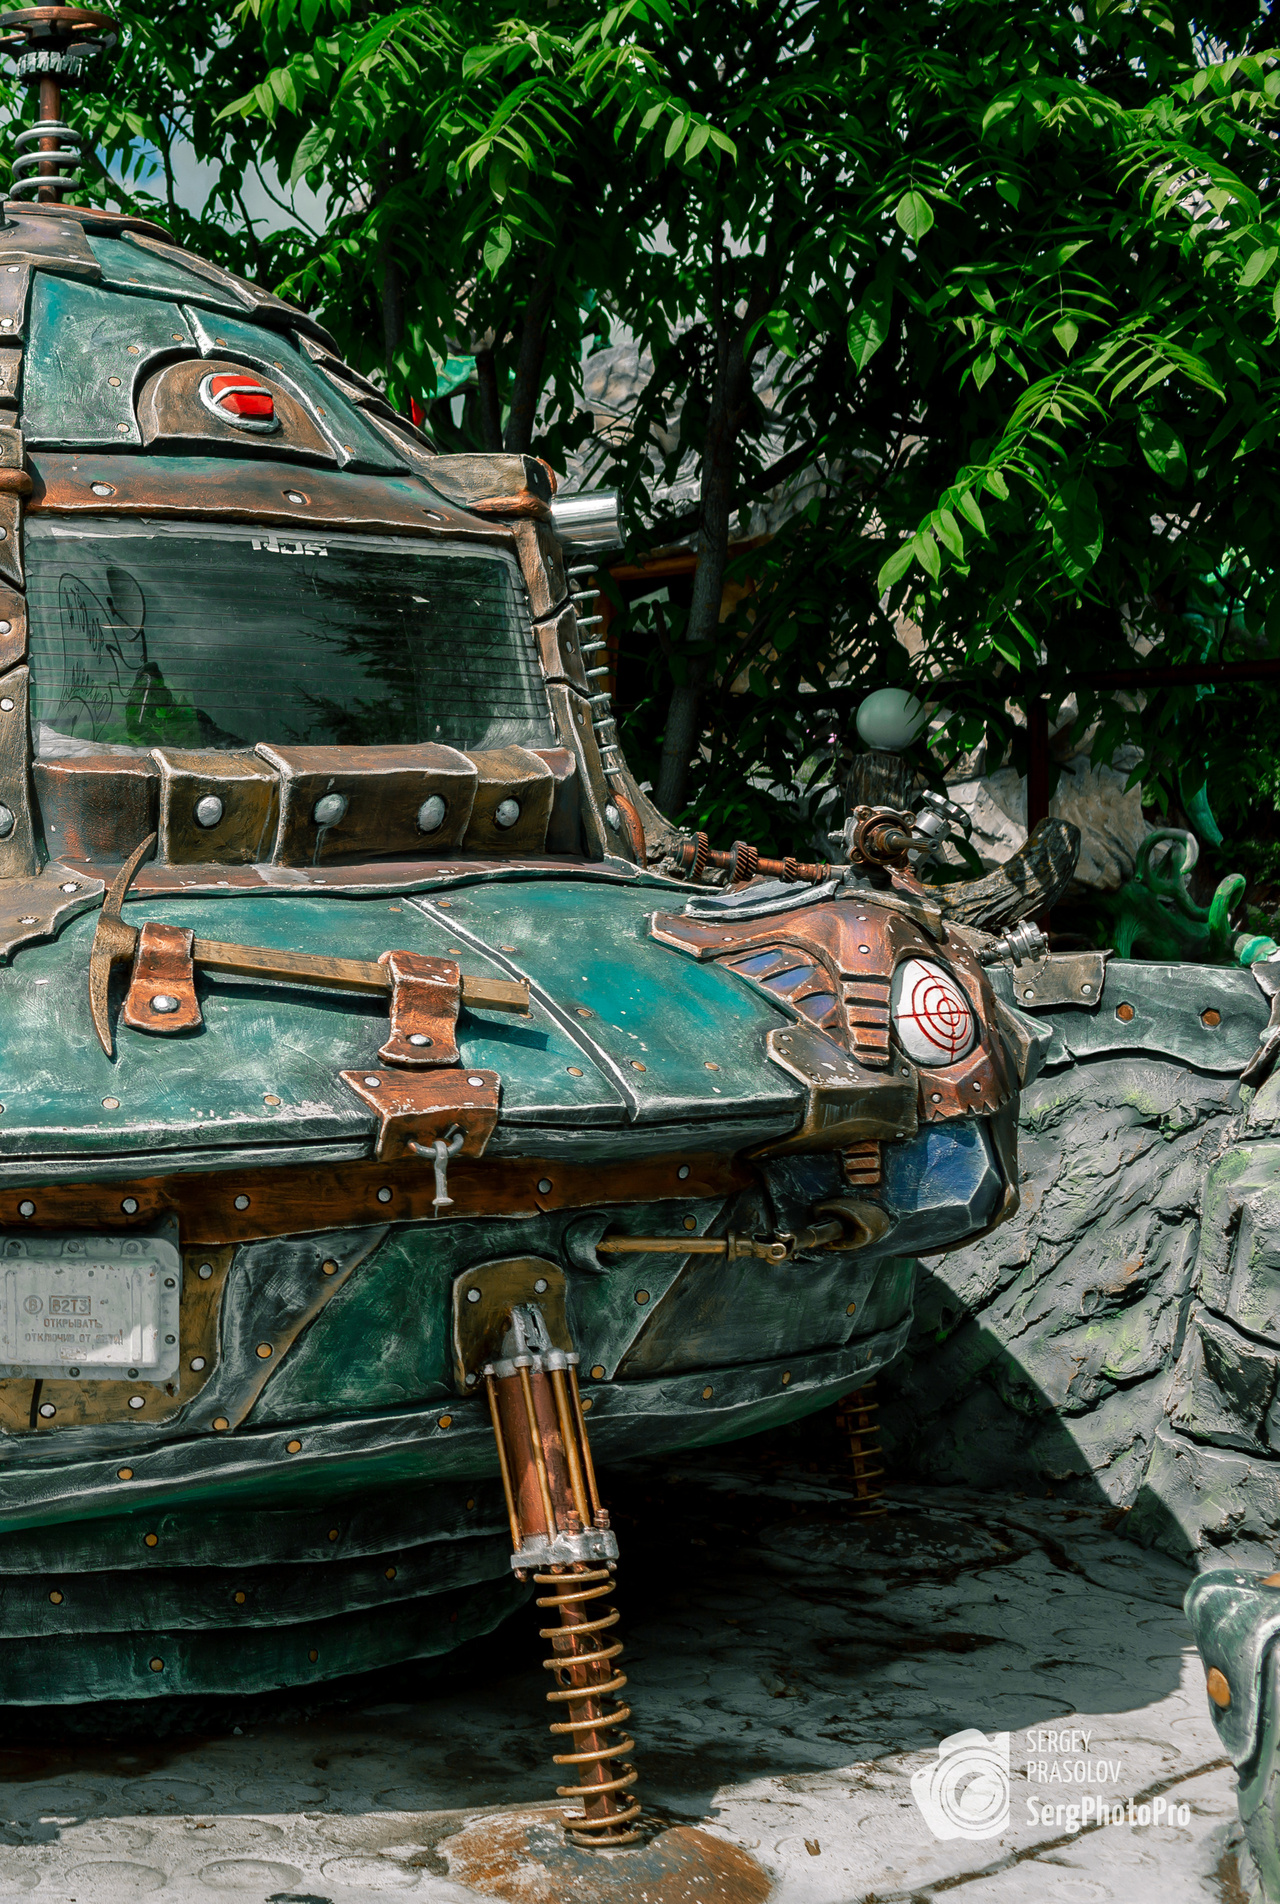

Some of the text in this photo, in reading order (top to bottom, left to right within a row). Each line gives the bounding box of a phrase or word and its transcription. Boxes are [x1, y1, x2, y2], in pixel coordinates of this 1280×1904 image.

[43, 1318, 103, 1328] ОТКРЫВАТЬ
[24, 1332, 75, 1342] ОТКЛЮЧИВ
[79, 1333, 91, 1343] ОТ
